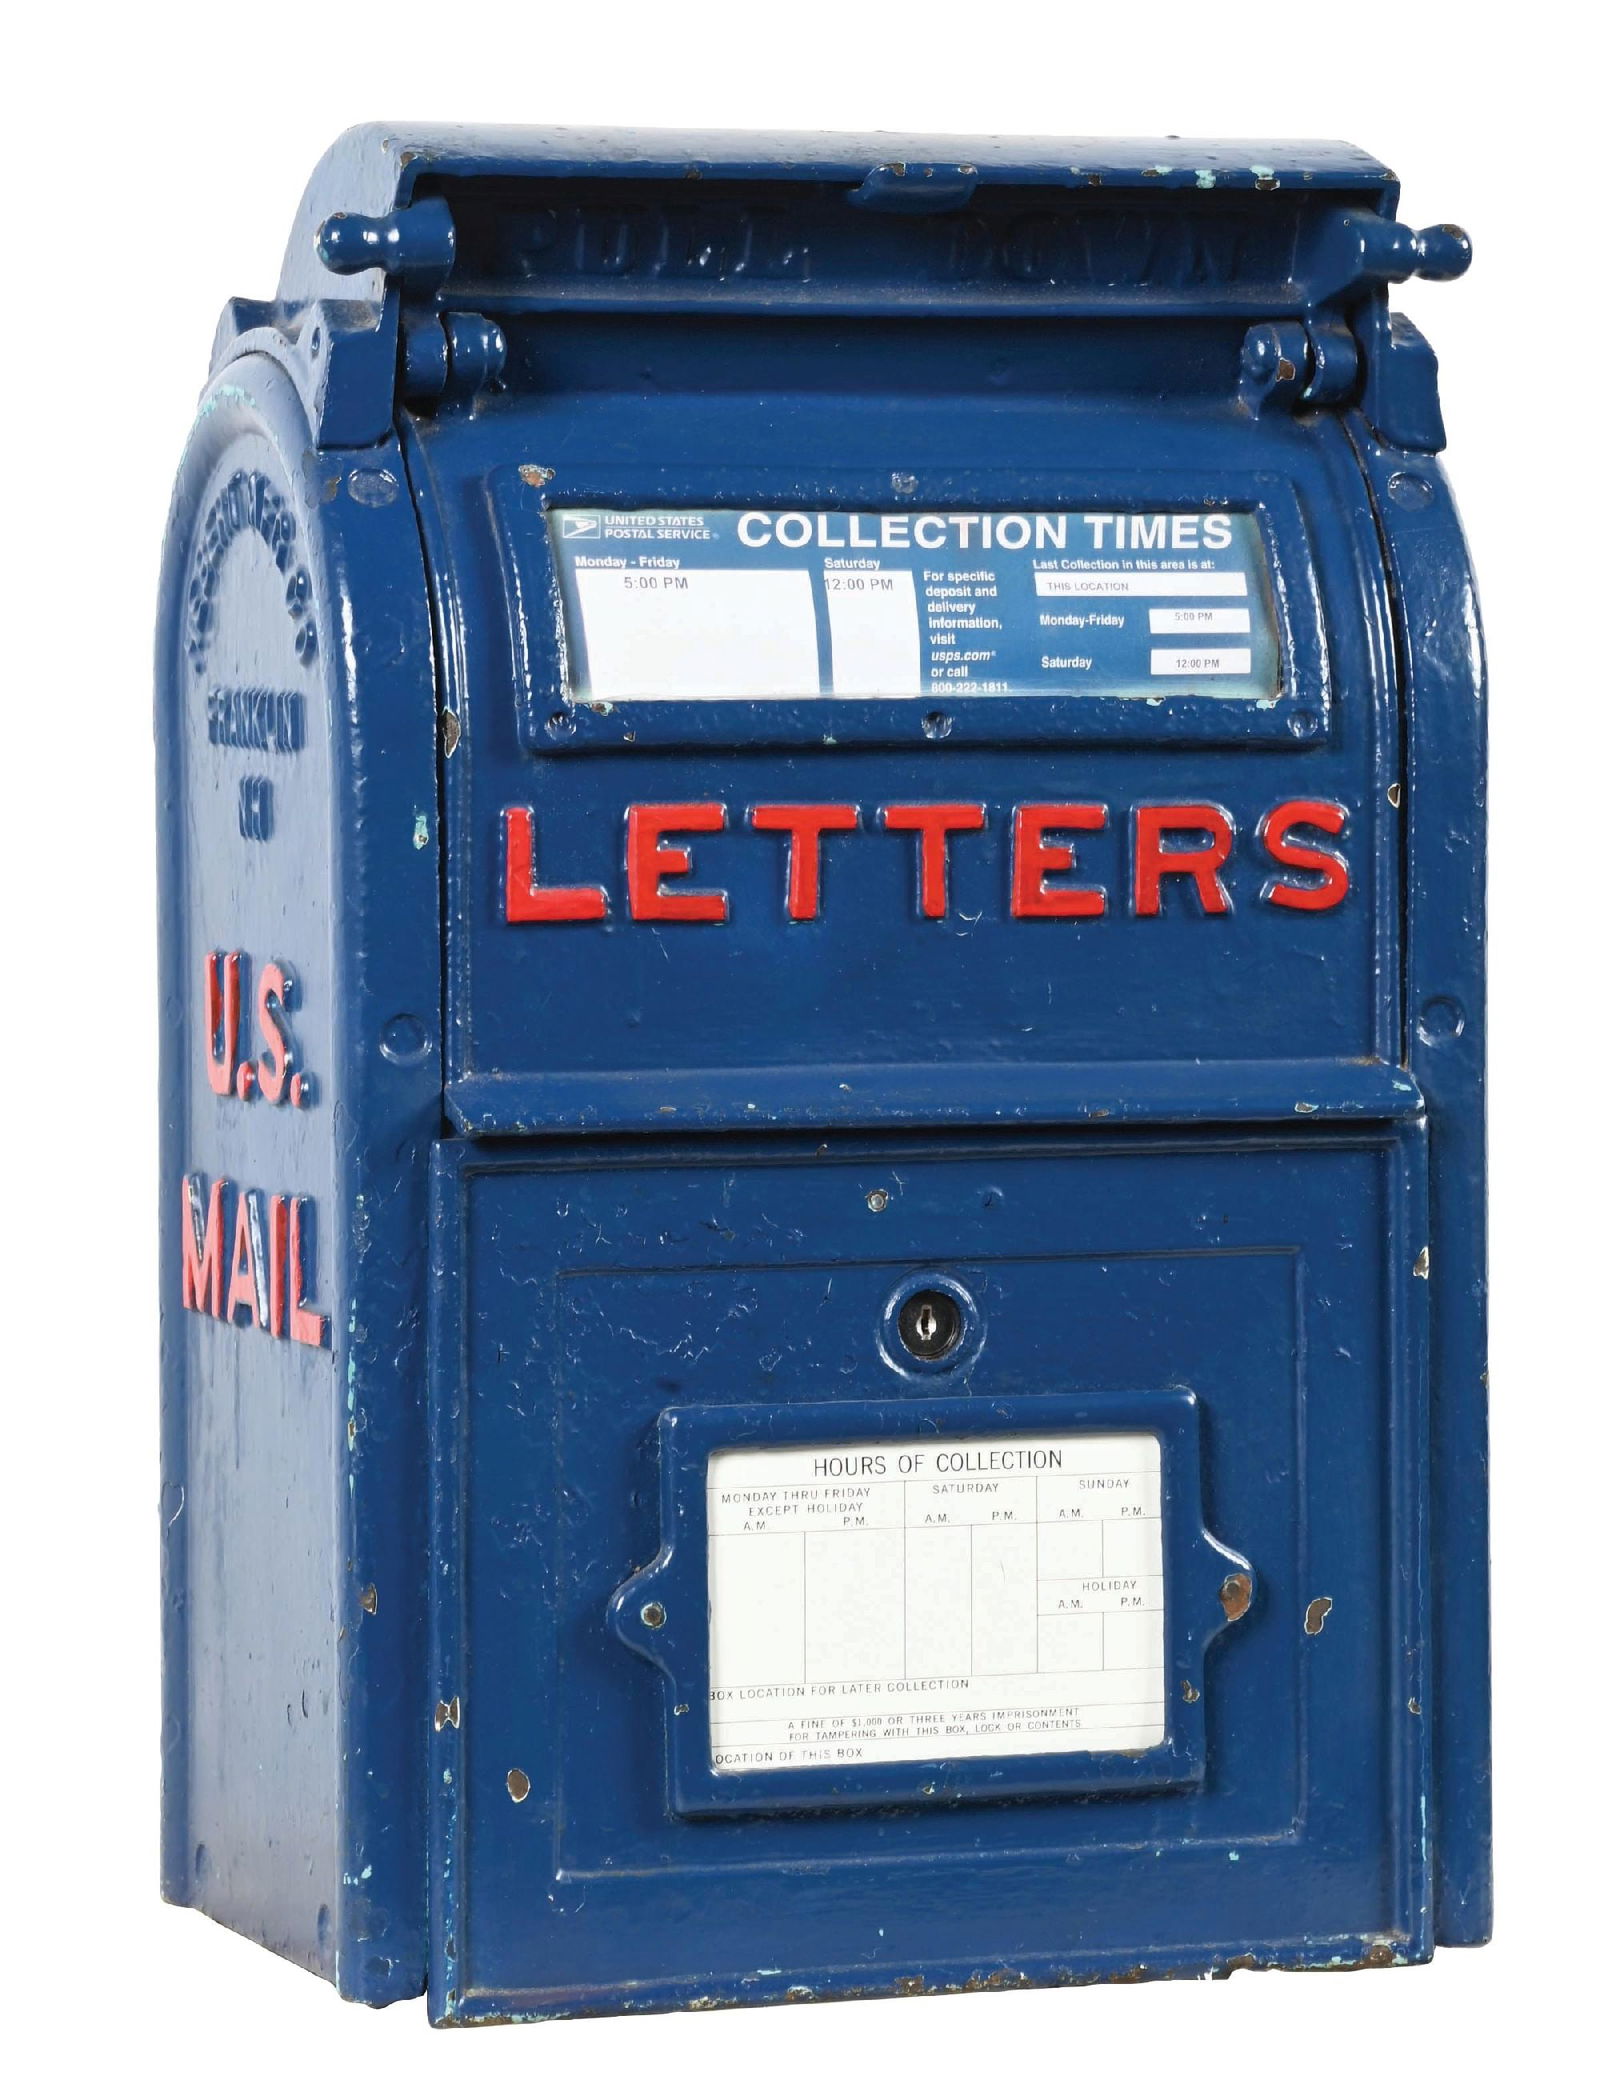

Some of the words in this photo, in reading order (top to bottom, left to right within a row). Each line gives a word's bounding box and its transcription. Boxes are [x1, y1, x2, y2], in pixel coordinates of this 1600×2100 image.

[605, 516, 655, 526] UNITED
[658, 516, 704, 526] STATES
[605, 529, 654, 539] POSTAL
[737, 512, 1067, 549] COLLECTION
[1084, 514, 1232, 549] TIMES
[575, 556, 627, 569] Monday
[639, 556, 681, 569] Friday
[824, 556, 881, 570] Saturday
[1032, 560, 1058, 570] Last
[1061, 559, 1119, 570] Collection
[1122, 559, 1133, 570] in
[1136, 559, 1158, 570] this
[1160, 562, 1185, 570] area
[1187, 559, 1198, 570] is
[1200, 560, 1215, 570] at:
[624, 576, 658, 589] 5:00
[664, 577, 689, 589] PM
[824, 577, 865, 591] 12:00
[870, 578, 894, 591] PM
[923, 570, 944, 581] For
[947, 570, 996, 585] specific
[925, 586, 972, 599] deposit
[975, 586, 998, 597] and
[1047, 582, 1071, 591] THIS
[1074, 582, 1129, 592] LOCATION
[927, 601, 976, 615] delivery
[1039, 614, 1124, 628] Monday-Friday
[1174, 612, 1195, 621] 5:00
[1198, 612, 1213, 621] PM
[928, 617, 1003, 630] information,
[930, 632, 956, 645] visit
[1041, 656, 1092, 670] Saturday
[1176, 659, 1201, 668] 12:00
[1204, 659, 1219, 668] PM
[931, 667, 944, 677] or
[947, 665, 968, 677] call
[503, 801, 1350, 922] LETTERS
[204, 951, 306, 1108] U.S.
[182, 1174, 326, 1347] MAIL
[814, 1455, 887, 1477] HOURS
[899, 1454, 925, 1474] OF
[936, 1450, 1063, 1473] COLLECTION
[932, 1482, 999, 1494] SATURDAY
[1079, 1479, 1130, 1490] SUNDAY
[721, 1492, 777, 1504] MONDAY
[784, 1490, 818, 1501] THRU
[825, 1487, 871, 1499] FRIDAY
[749, 1505, 799, 1517] EXCEPT
[807, 1502, 864, 1514] HOLIDAY
[1059, 1509, 1085, 1518] A.M.
[1121, 1507, 1146, 1517] P.M.
[843, 1516, 869, 1527] P.M.
[925, 1514, 951, 1524] A.M.
[992, 1511, 1017, 1521] P.M.
[1083, 1580, 1137, 1592] HOLIDAY
[1058, 1599, 1084, 1609] A.M.
[1120, 1597, 1145, 1607] P.M.
[709, 1690, 734, 1701] BOX
[740, 1687, 805, 1700] LOCATION
[811, 1686, 836, 1696] FOR
[842, 1683, 881, 1695] LATER
[887, 1679, 969, 1693] COLLECTION
[788, 1721, 795, 1730] A
[801, 1720, 825, 1730] FINE
[832, 1719, 845, 1729] OF
[851, 1717, 882, 1728] $1,000
[888, 1716, 903, 1726] OR
[910, 1714, 945, 1725] THREE
[952, 1711, 987, 1723] YEARS
[992, 1708, 1080, 1721] IMPRISONMENT
[789, 1732, 809, 1742] FOR
[816, 1729, 877, 1740] TAMPERING
[883, 1727, 909, 1737] WITH
[916, 1726, 939, 1736] THIS
[946, 1724, 969, 1735] BOX,
[975, 1723, 1001, 1733] LOCK
[1007, 1722, 1021, 1732] OR
[1028, 1719, 1081, 1730] CONTENTS
[714, 1752, 773, 1765] OCATION
[779, 1751, 793, 1761] OF
[801, 1749, 831, 1760] THIS
[837, 1747, 863, 1758] BOX
